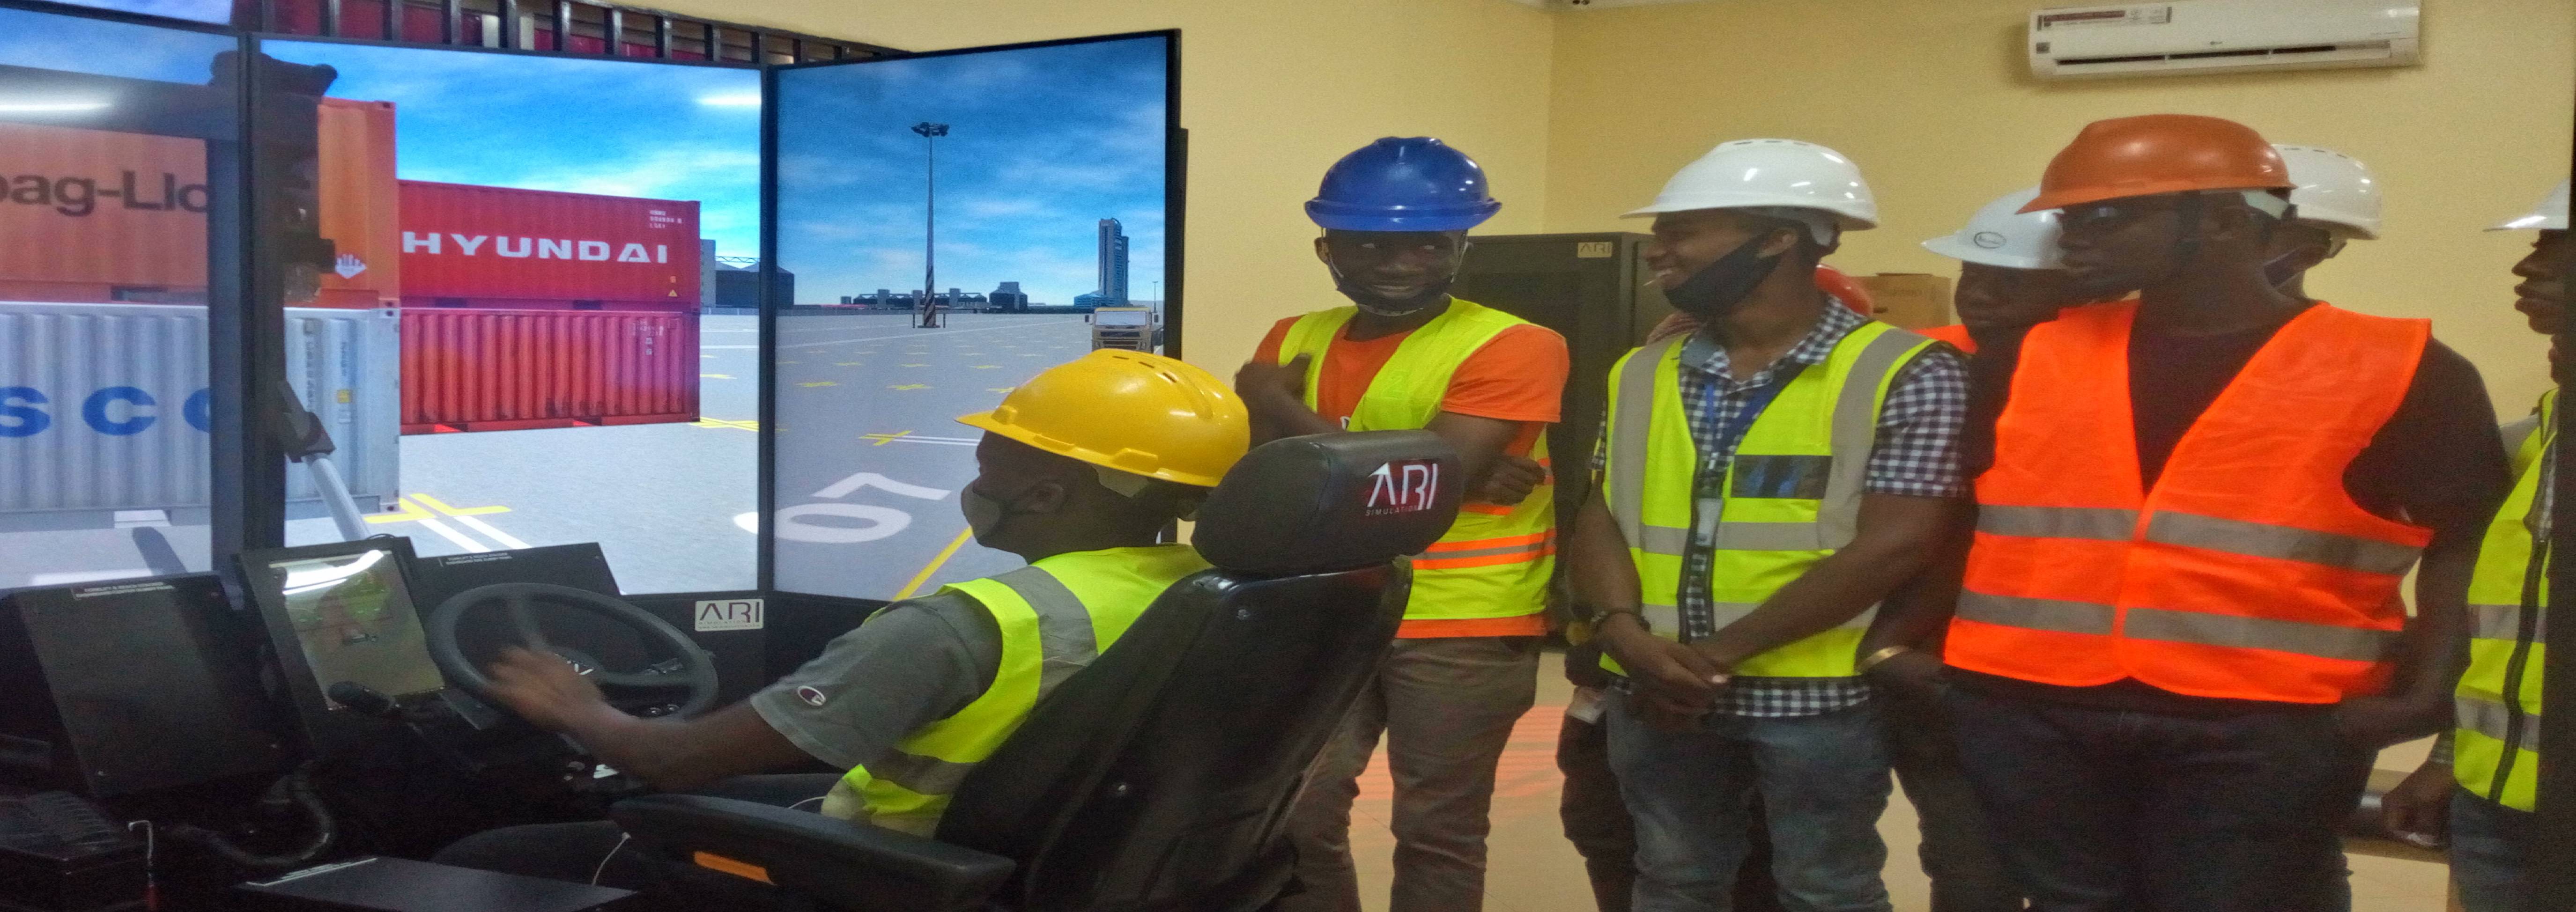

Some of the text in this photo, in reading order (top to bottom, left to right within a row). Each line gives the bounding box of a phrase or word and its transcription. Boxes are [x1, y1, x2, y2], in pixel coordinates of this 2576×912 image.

[0, 171, 207, 217] ag-Llo
[402, 231, 667, 263] HYUNDAI
[1367, 462, 1438, 510] ARI
[700, 602, 760, 623] ARI
